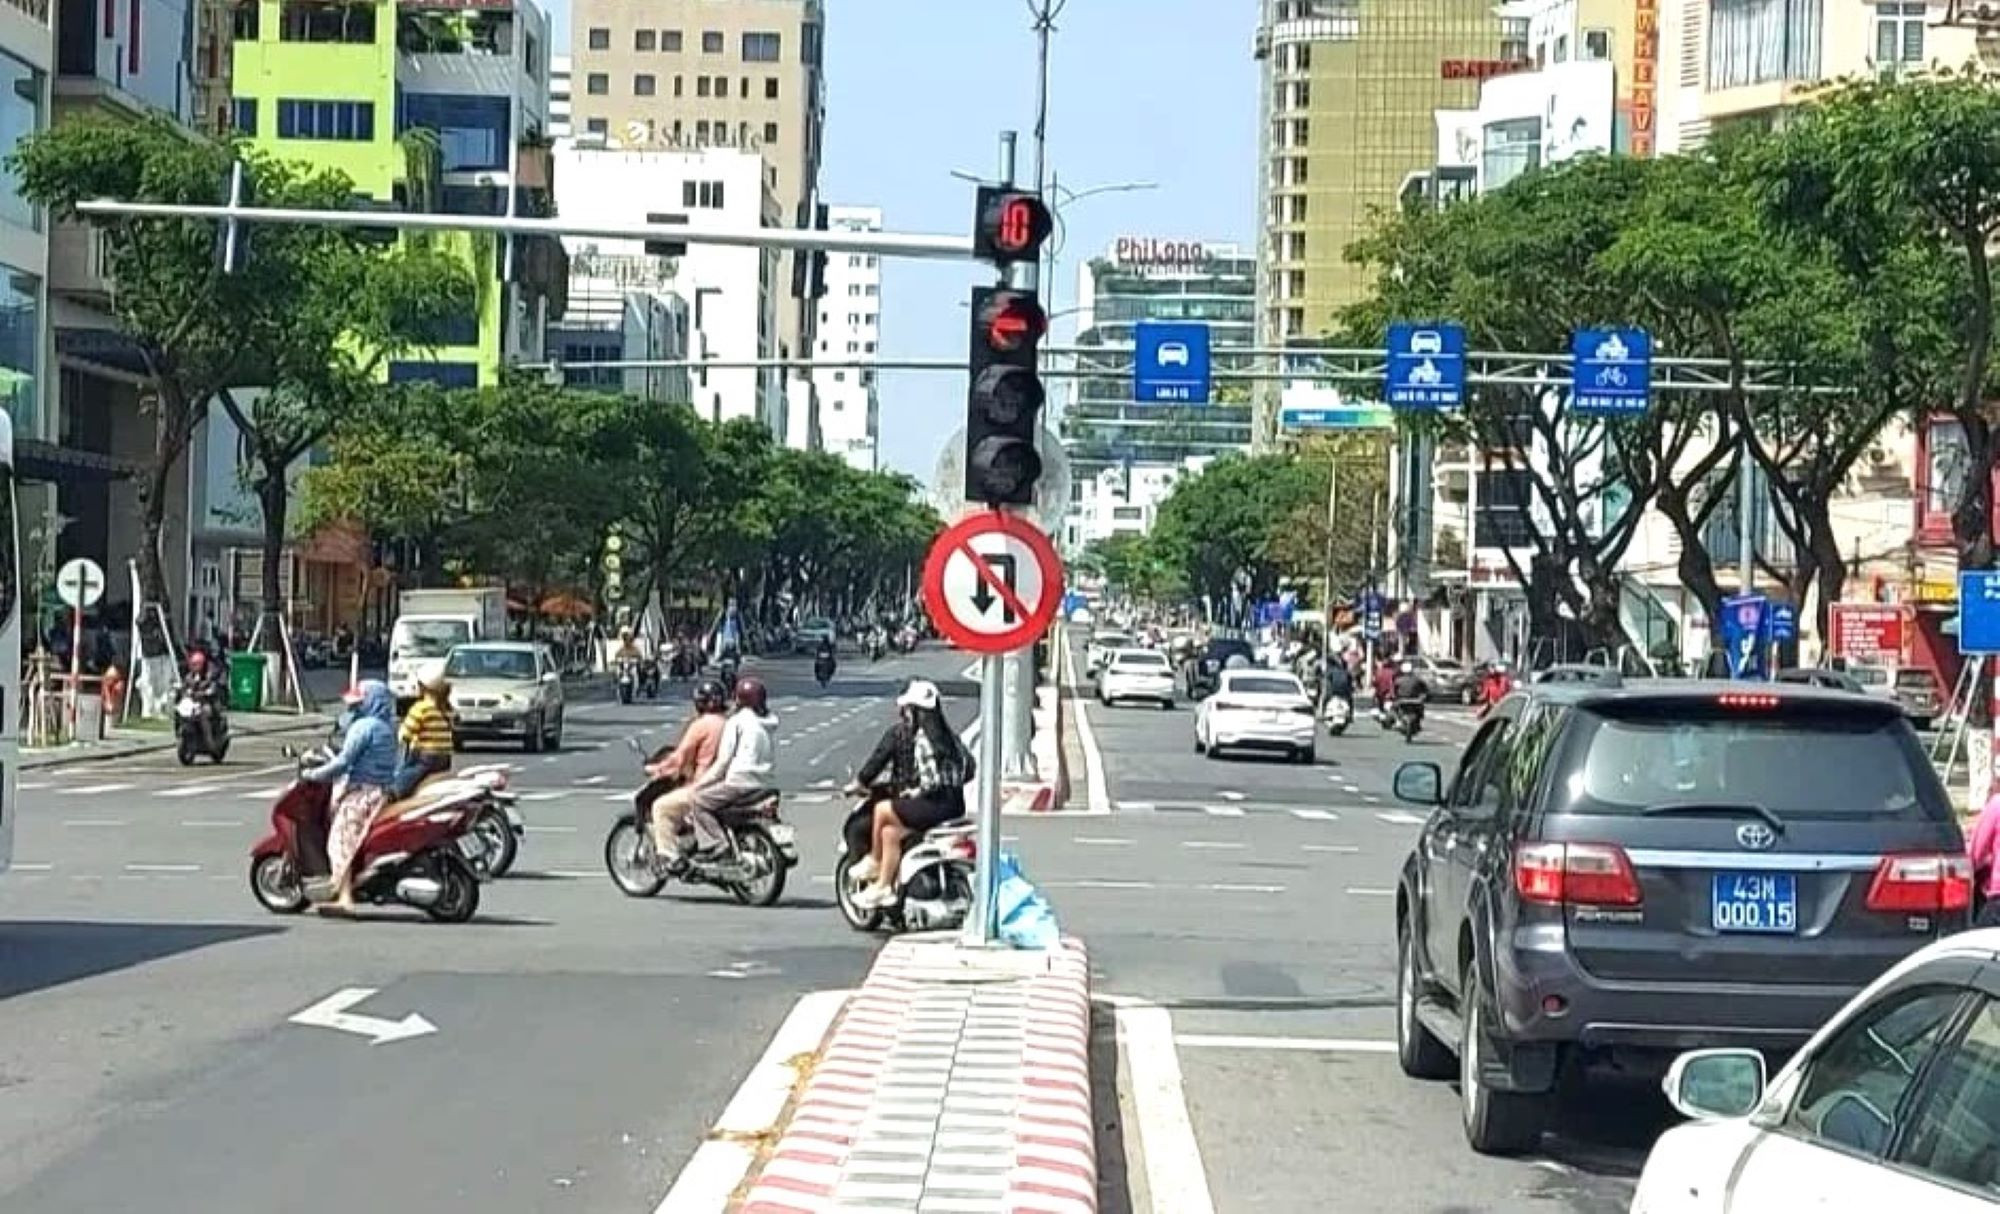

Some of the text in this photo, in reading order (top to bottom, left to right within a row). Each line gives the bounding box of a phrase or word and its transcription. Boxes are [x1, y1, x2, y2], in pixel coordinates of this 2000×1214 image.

[1002, 203, 1029, 248] 10
[1733, 875, 1776, 901] 43M
[1718, 901, 1793, 927] 000.15
